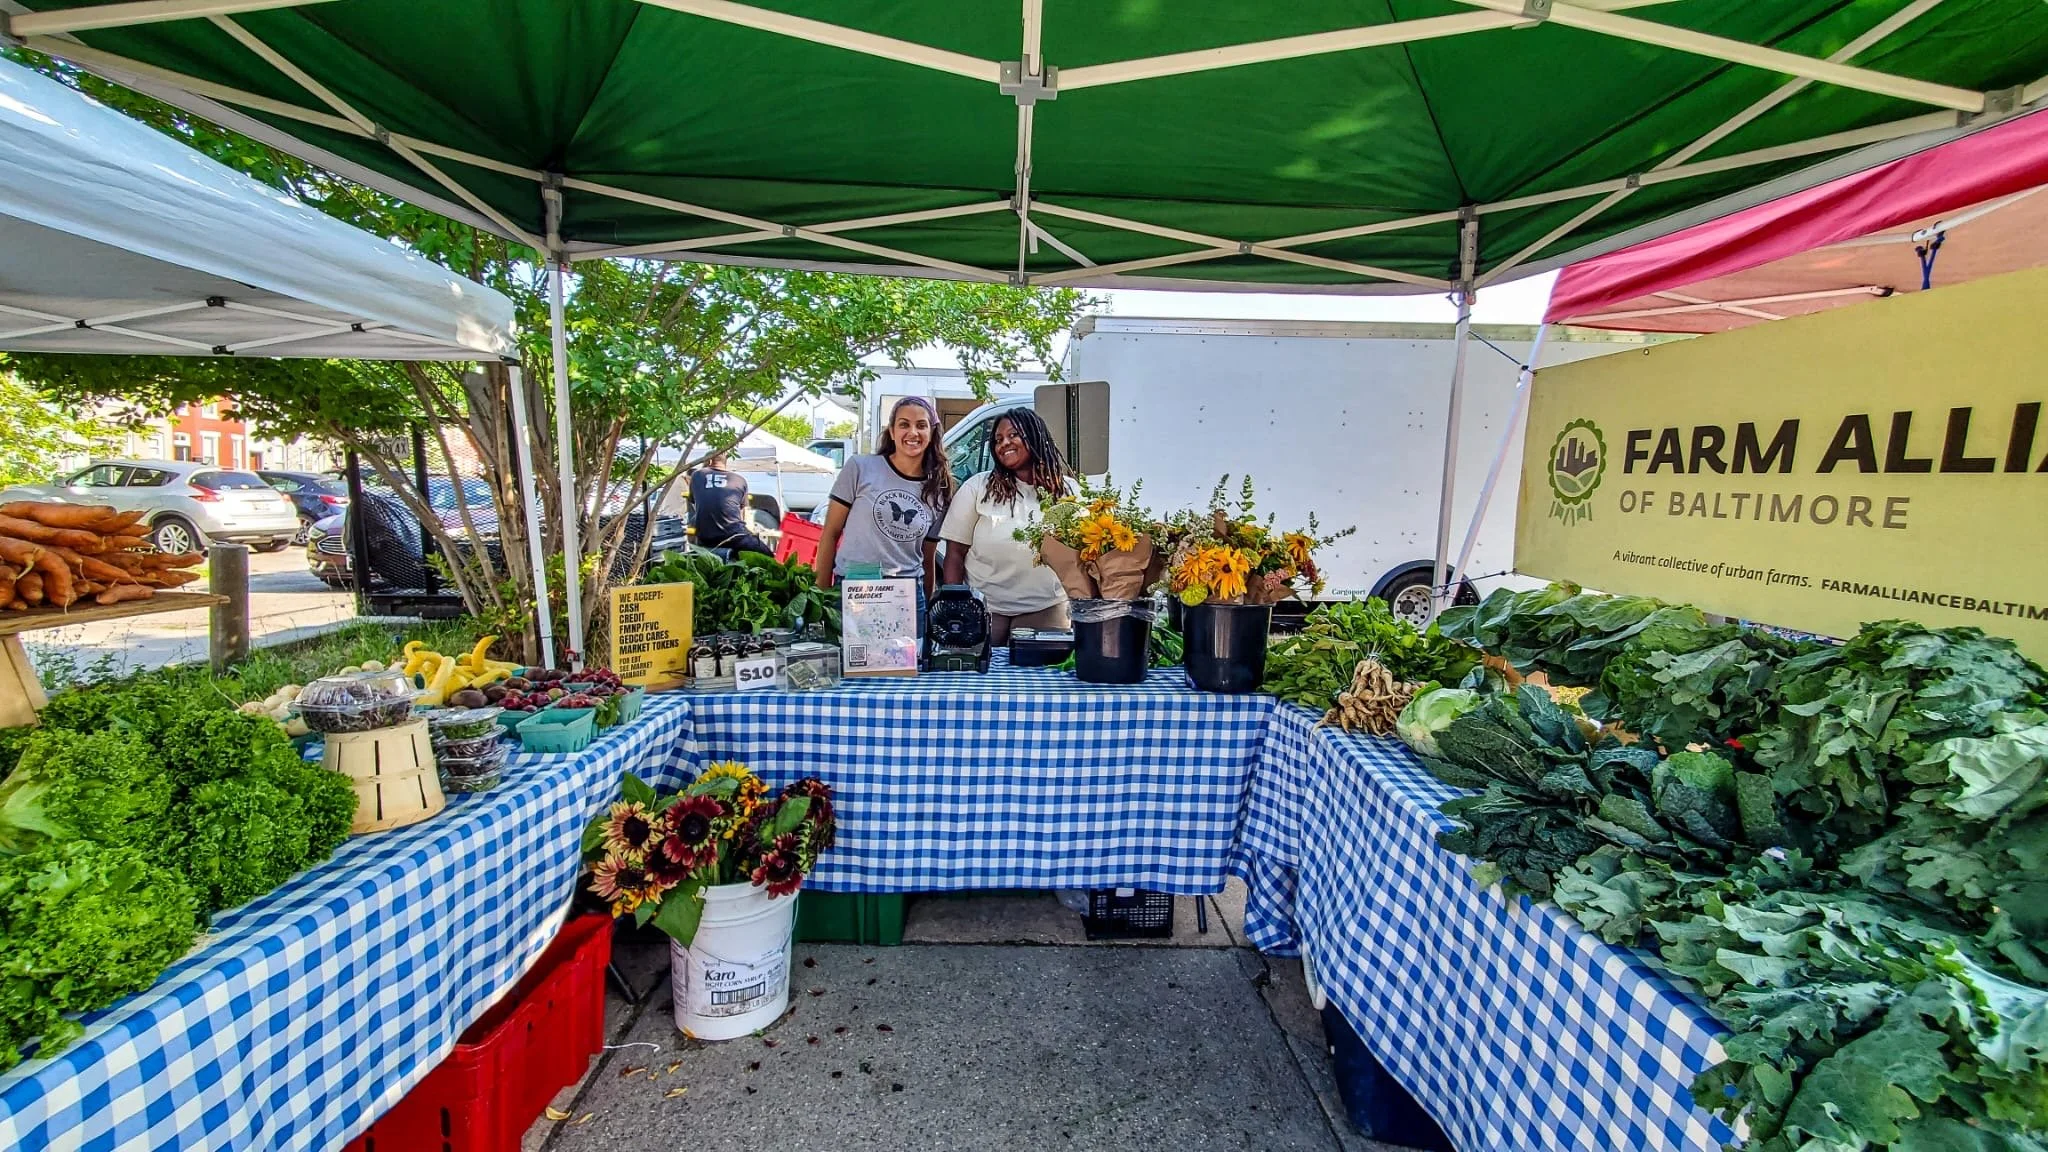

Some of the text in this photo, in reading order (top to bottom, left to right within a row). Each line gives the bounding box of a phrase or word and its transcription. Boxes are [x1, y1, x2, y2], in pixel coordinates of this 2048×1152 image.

[1623, 401, 2048, 474] FARM ALLI
[705, 473, 728, 489] 15
[1619, 490, 1910, 529] OF BALTIMORE
[1612, 550, 1621, 561] A
[1622, 551, 1657, 566] vibrant
[1658, 556, 1709, 573] collective
[1710, 562, 1725, 578] of
[1725, 565, 1763, 581] urban
[1766, 569, 1812, 588] farms.
[619, 590, 664, 603] WE ACCEPT:
[619, 603, 640, 614] CASH
[619, 612, 646, 624] CREDIT
[619, 621, 660, 634] FMNP/FVC
[619, 630, 669, 645] GEDCO CARES
[619, 639, 680, 655] MARKET TOKENS
[619, 656, 630, 665] FOR
[619, 661, 653, 673] SEE MARKET
[739, 666, 774, 682] $10
[705, 969, 736, 981] Karo
